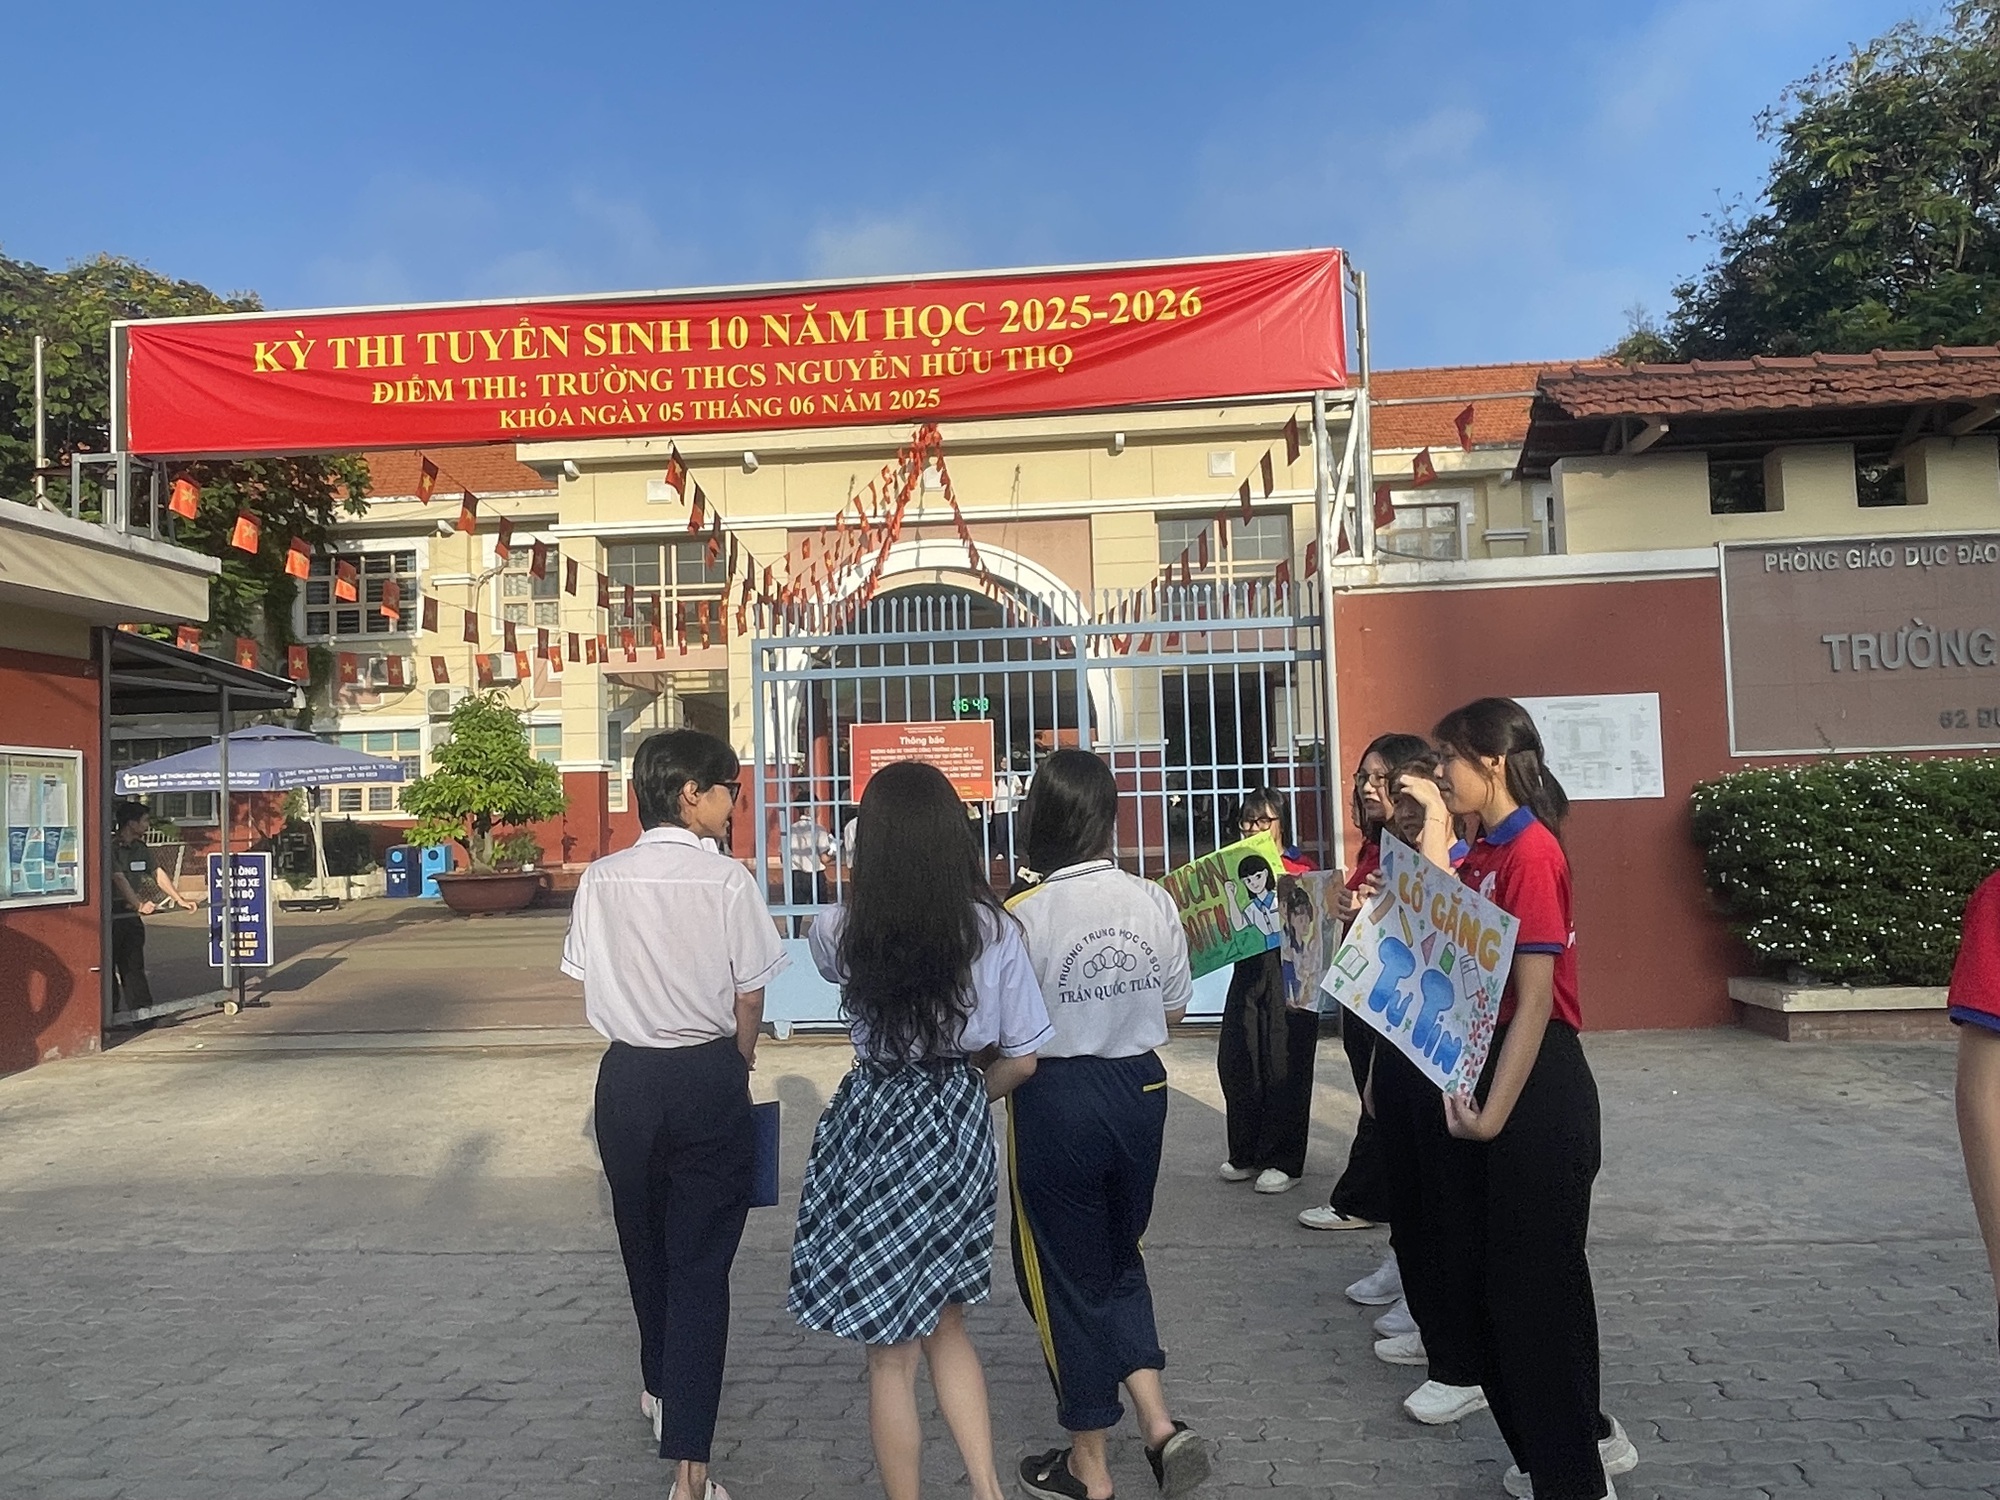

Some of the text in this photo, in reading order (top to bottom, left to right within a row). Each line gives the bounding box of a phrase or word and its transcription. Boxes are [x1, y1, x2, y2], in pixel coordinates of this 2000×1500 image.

[253, 286, 1202, 373] KỲ THI TUYỂN SINH 10 NĂM HỌC 2025-2026
[371, 344, 1073, 404] ĐIỂM THI: TRƯỜNG THCS NGUYỄN HỮU THỌ
[499, 387, 941, 429] KHÓA NGÀY 05 THÁNG 06 NĂM 2025
[1764, 545, 1840, 573] PHÒNG
[1845, 542, 1896, 569] GIÁO
[1904, 544, 1949, 572] DỤC
[1822, 617, 1999, 672] TRƯỜNG
[899, 735, 946, 746] Thông báo
[1081, 927, 1116, 945] TRUNG
